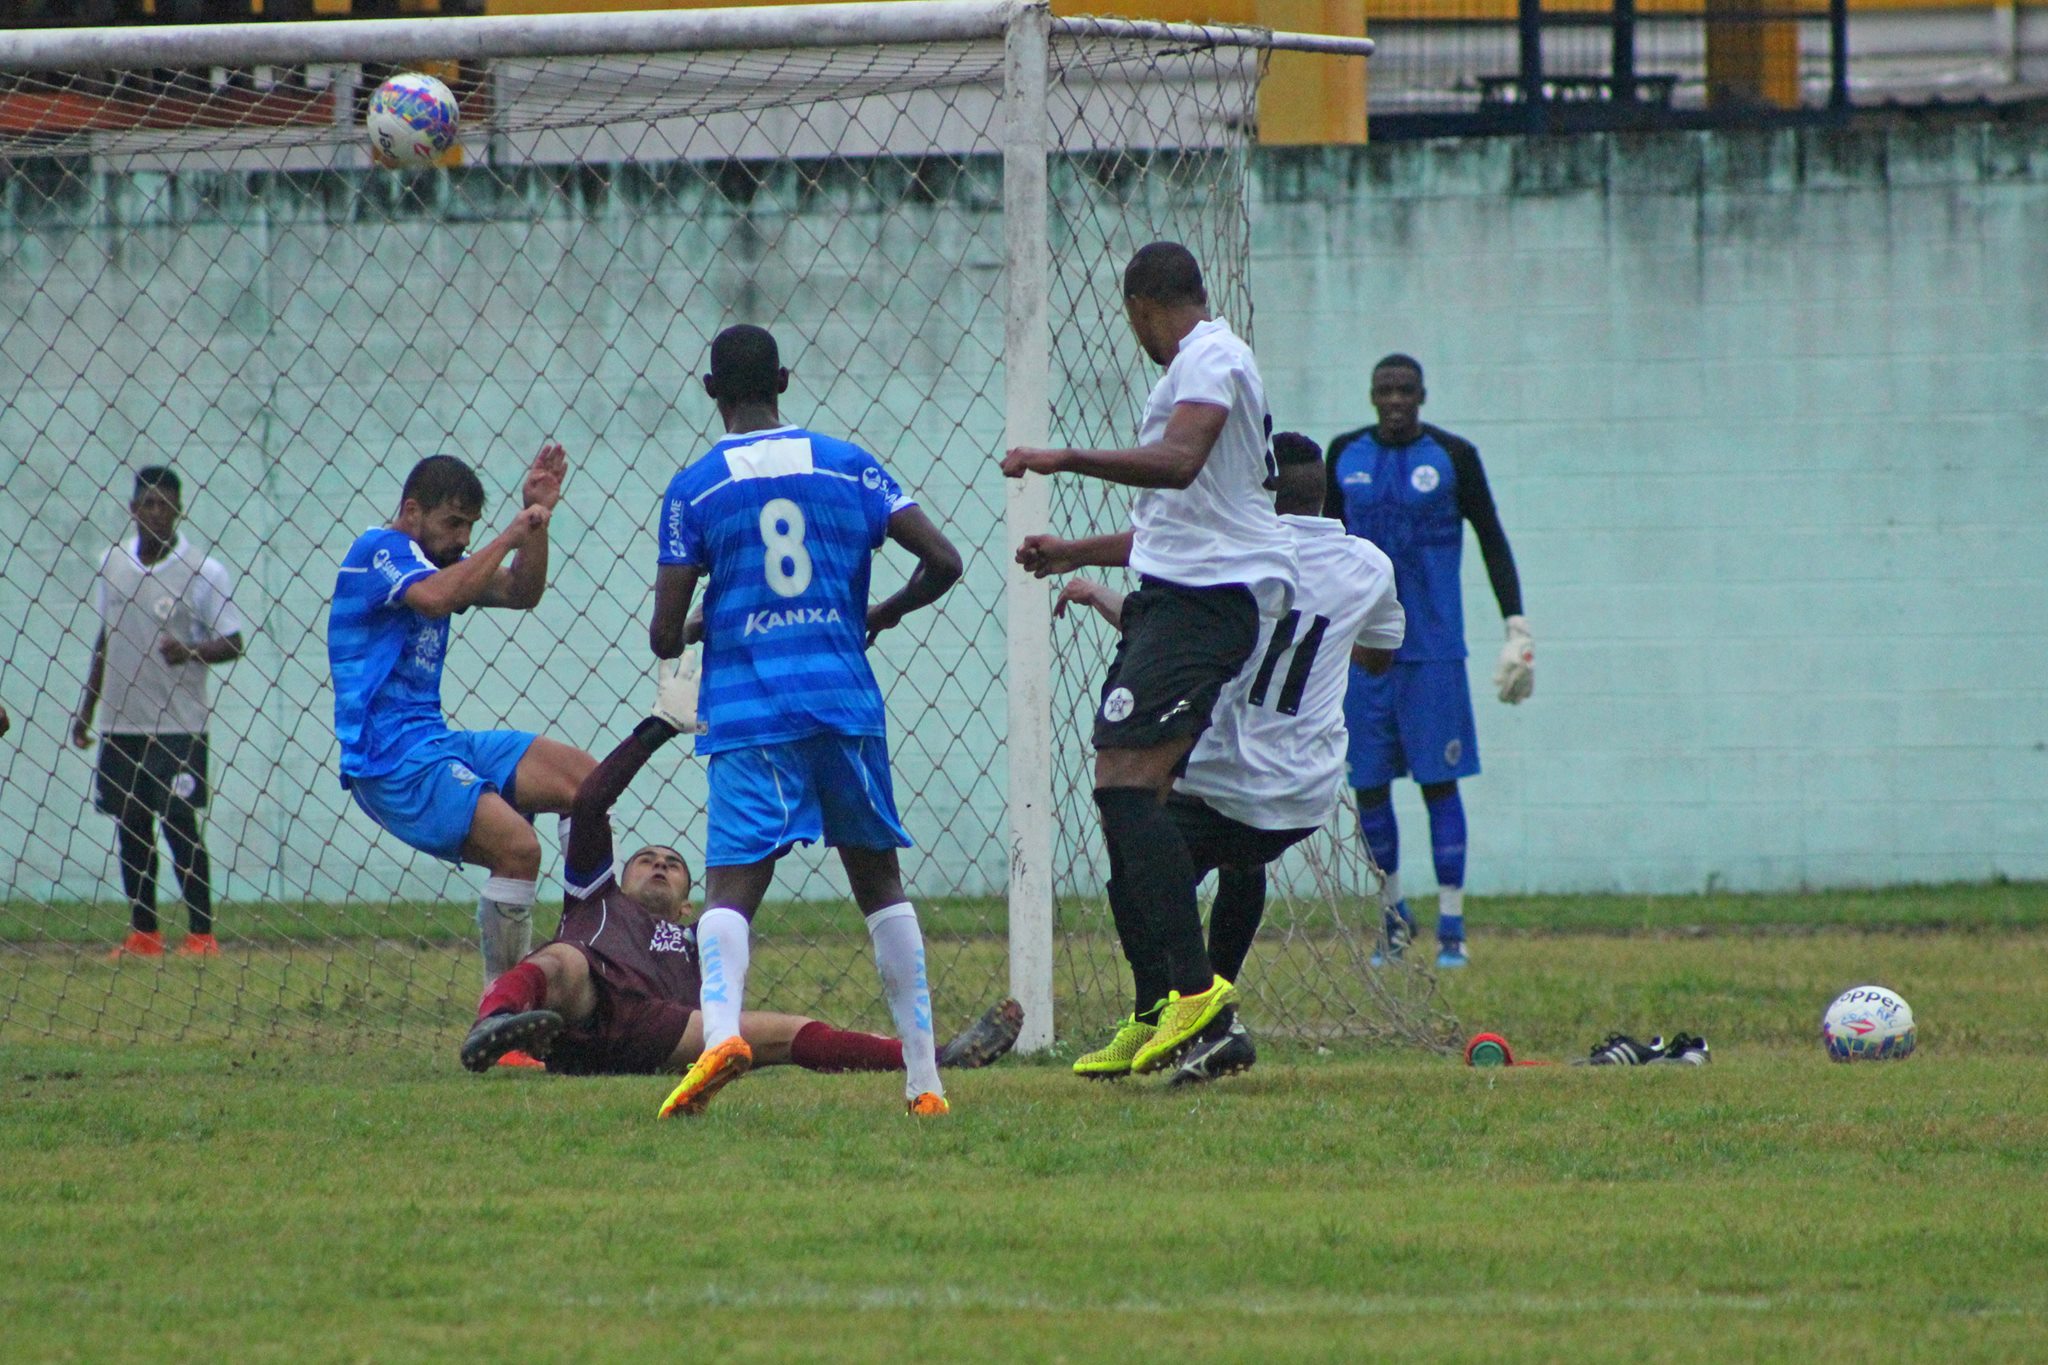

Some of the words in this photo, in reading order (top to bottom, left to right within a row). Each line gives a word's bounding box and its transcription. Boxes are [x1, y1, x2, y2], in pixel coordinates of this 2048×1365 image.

[669, 498, 682, 540] SAME
[759, 497, 813, 598] 8
[743, 607, 841, 637] KANXA
[1248, 609, 1331, 717] 11
